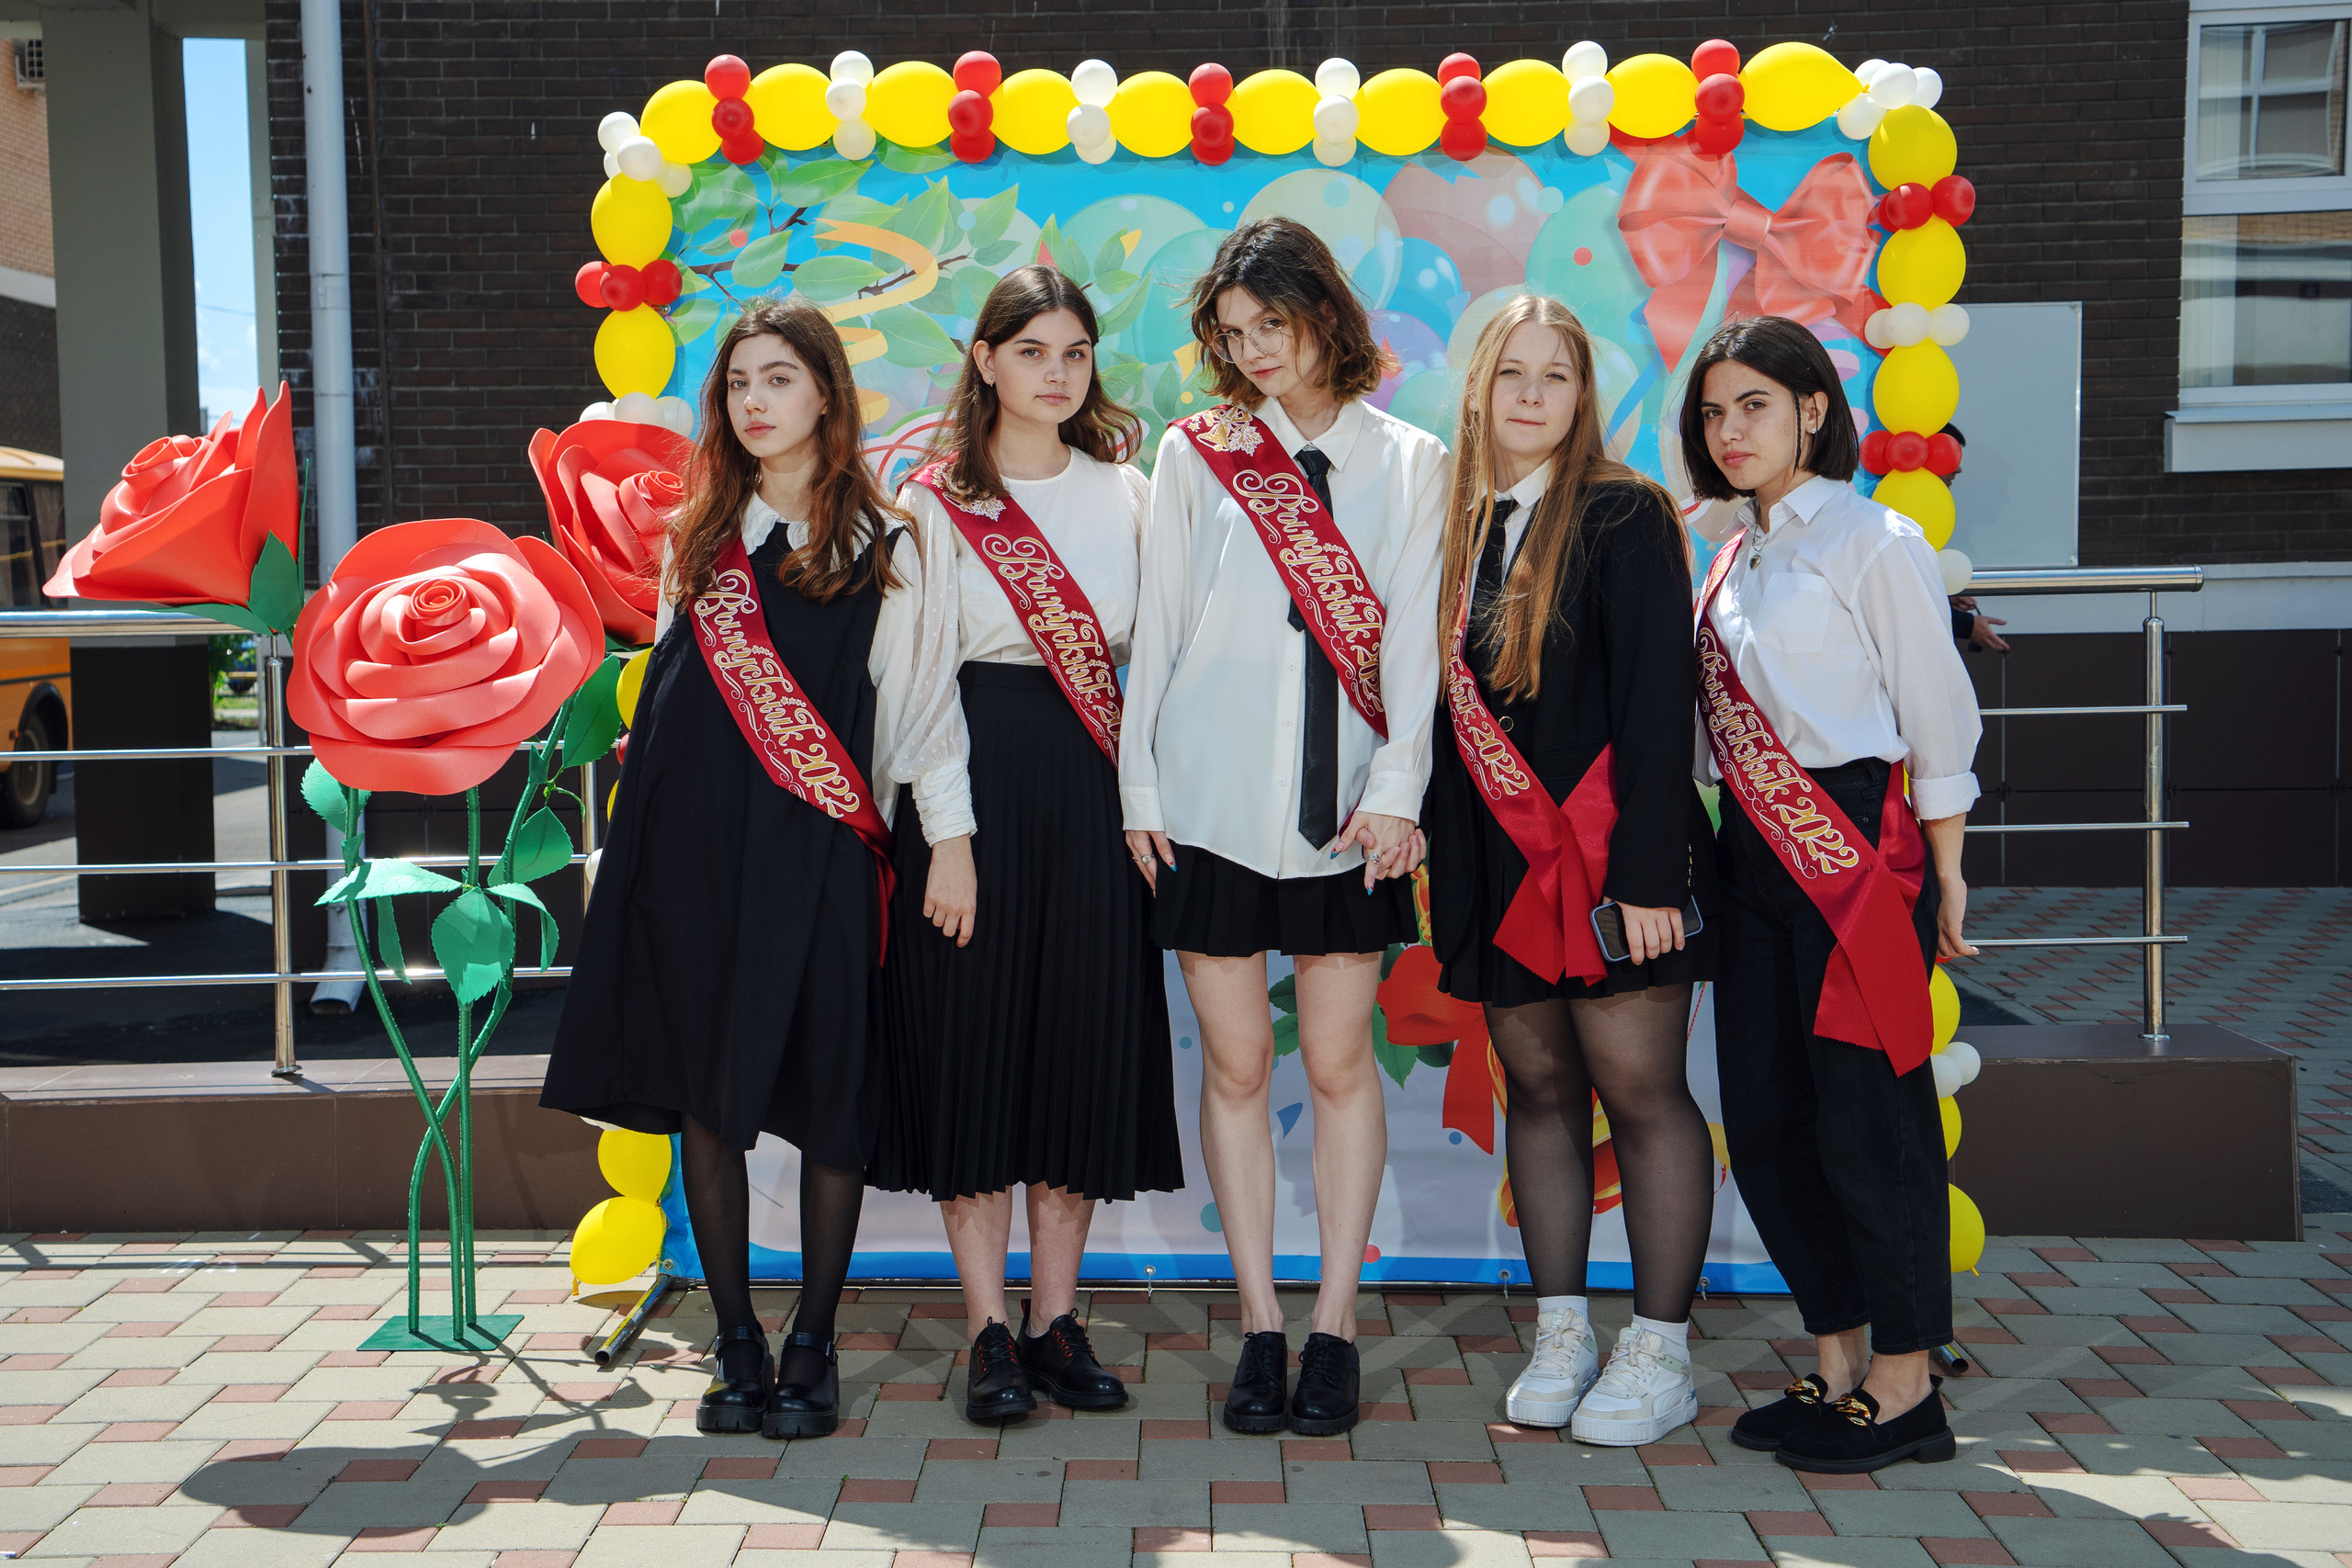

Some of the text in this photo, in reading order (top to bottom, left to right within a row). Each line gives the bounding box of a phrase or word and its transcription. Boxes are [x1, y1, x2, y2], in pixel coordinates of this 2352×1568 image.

[981, 533, 1122, 741] Выпускник 20
[1233, 468, 1383, 643] Выпускник
[694, 566, 860, 818] Выпускник 2022
[1468, 721, 1530, 795] 2022
[1694, 626, 1860, 874] Выпускник 2022
